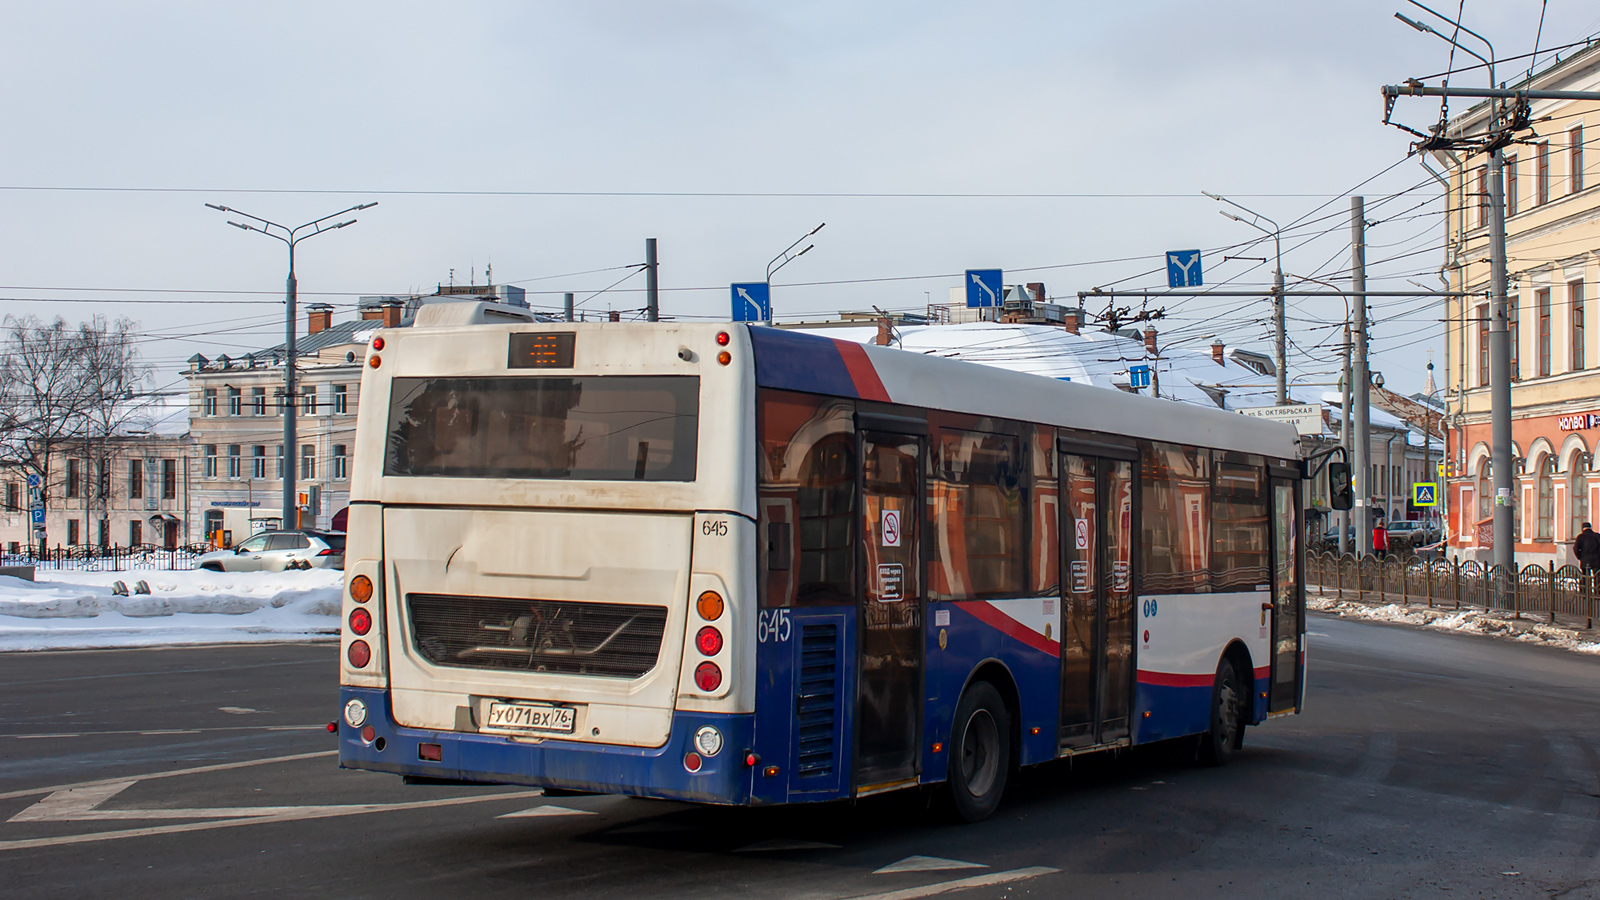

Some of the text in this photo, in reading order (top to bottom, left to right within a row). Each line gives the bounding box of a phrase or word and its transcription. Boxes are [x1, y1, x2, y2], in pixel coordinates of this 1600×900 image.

[1265, 407, 1313, 416] ОКТЯБРЬСКАЯ
[702, 520, 728, 536] 645
[758, 608, 791, 643] 645
[496, 706, 568, 727] У071ВХ 76
